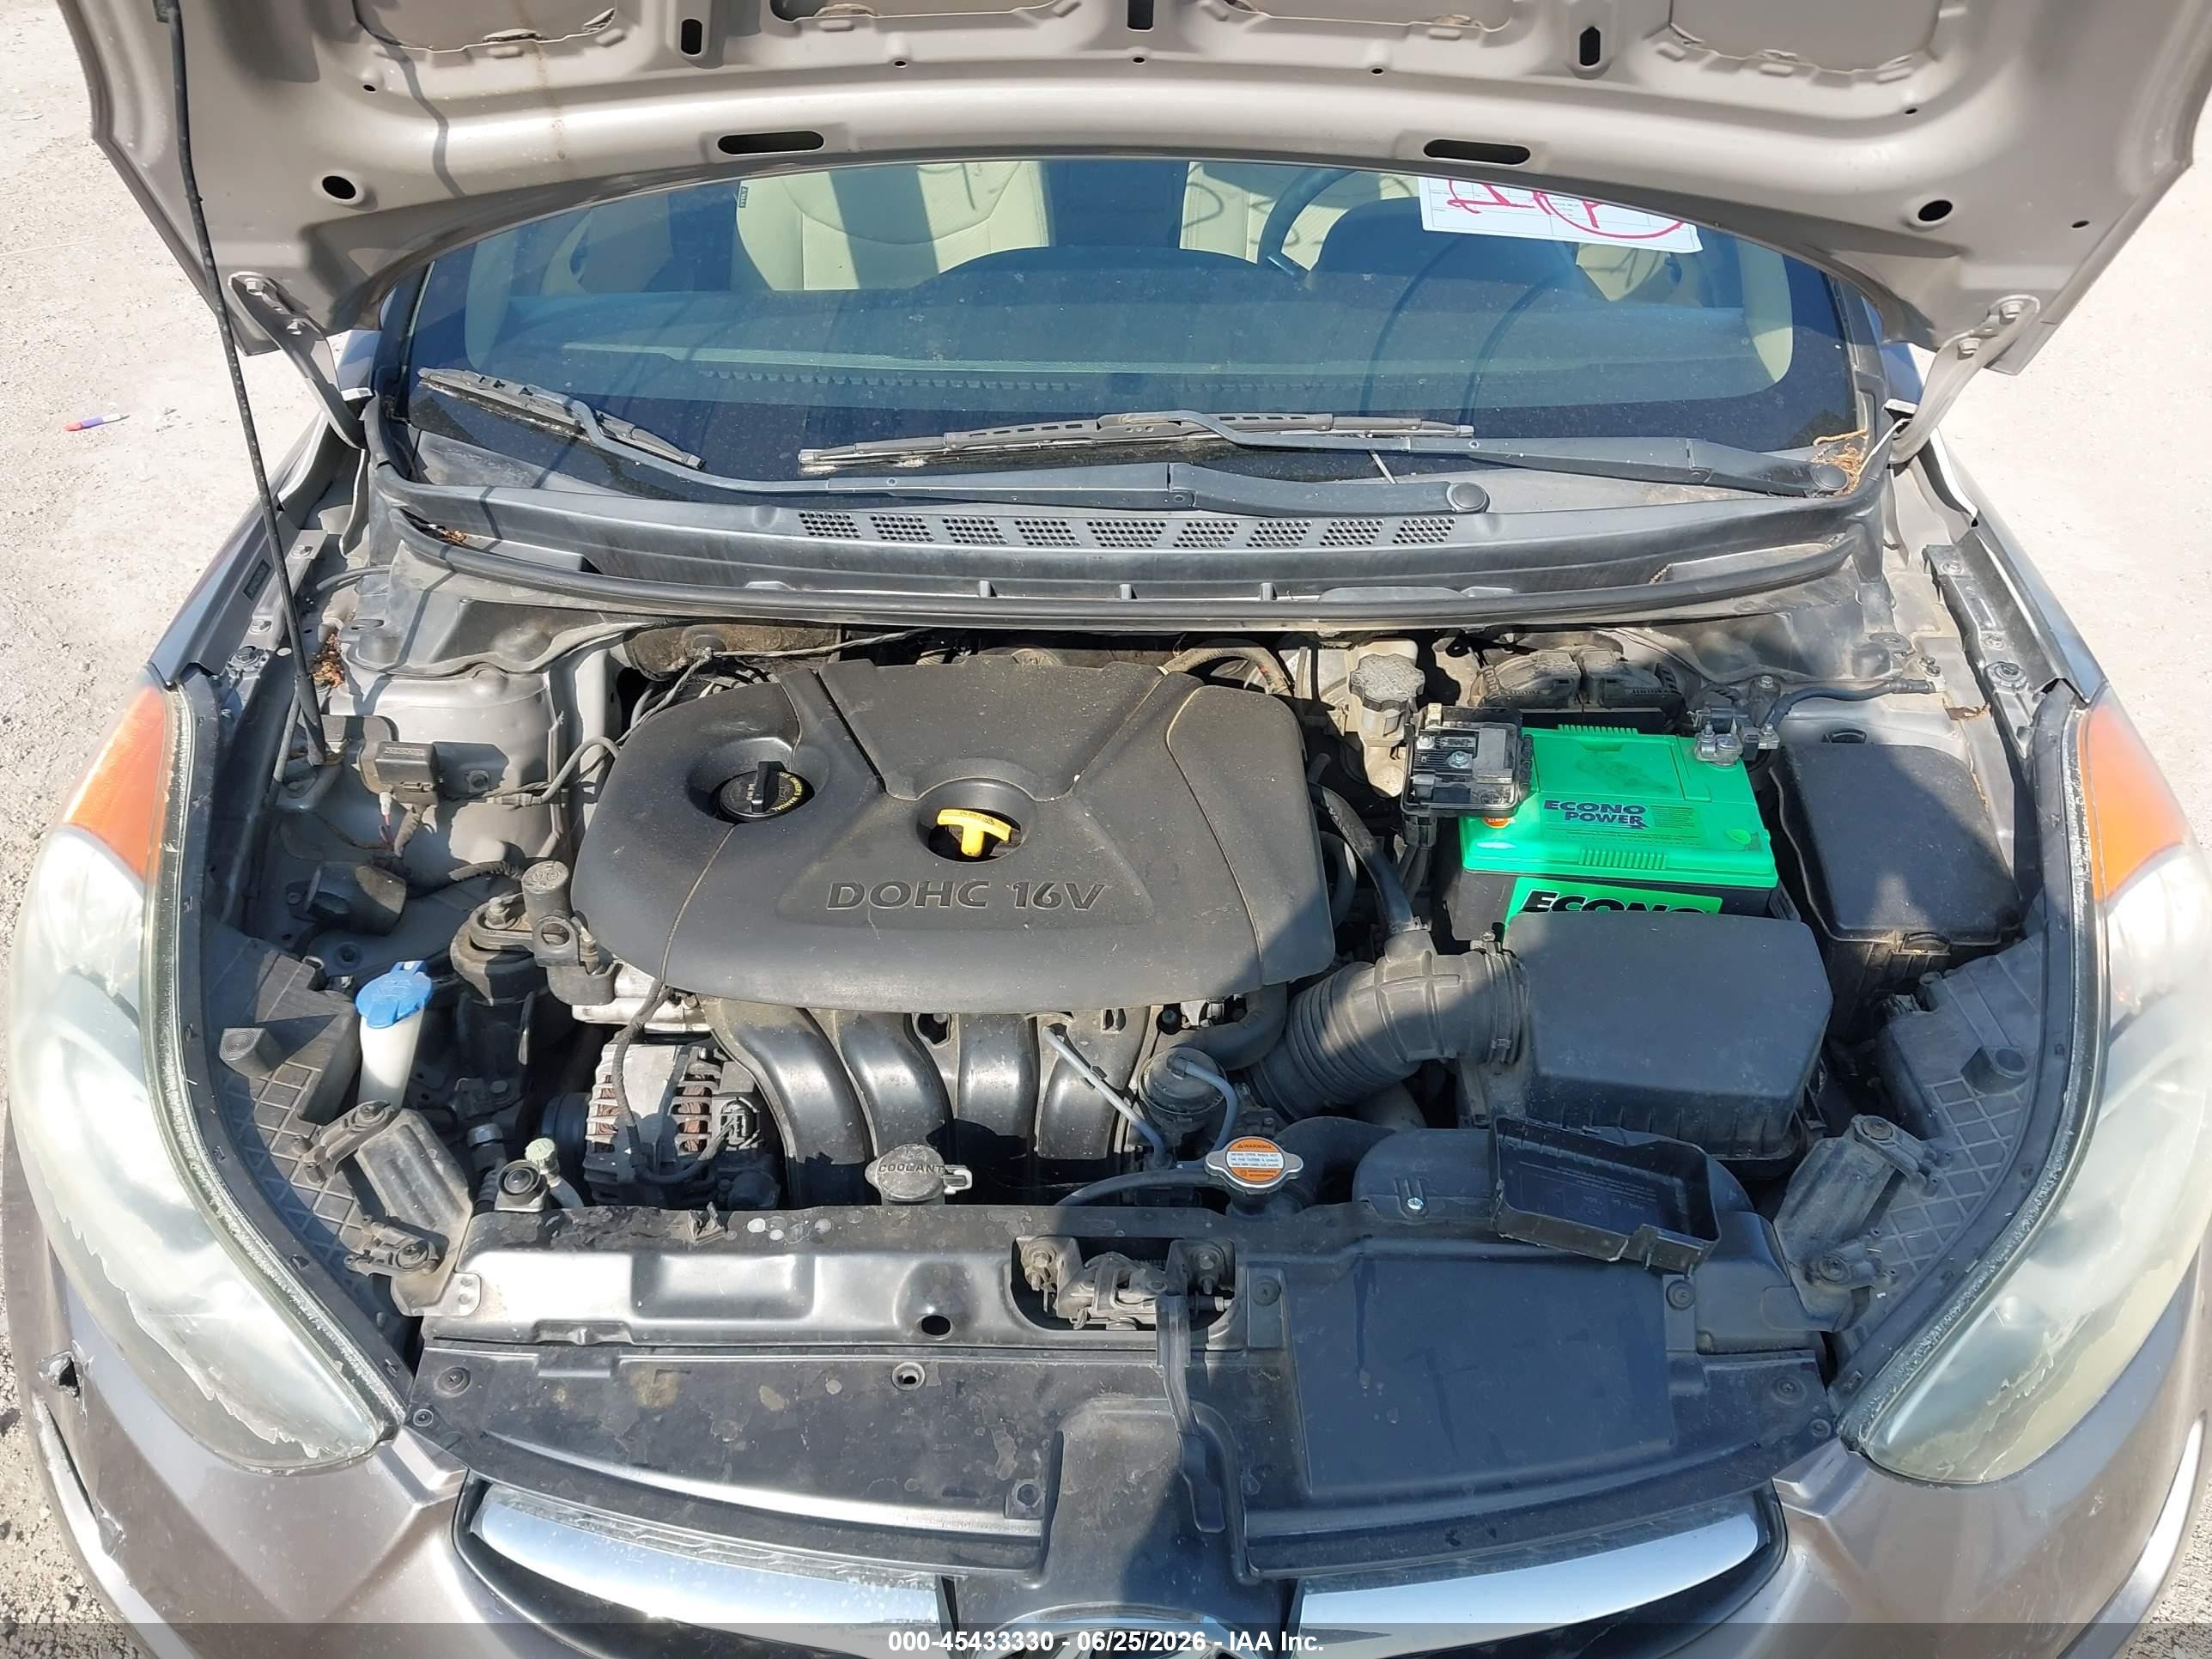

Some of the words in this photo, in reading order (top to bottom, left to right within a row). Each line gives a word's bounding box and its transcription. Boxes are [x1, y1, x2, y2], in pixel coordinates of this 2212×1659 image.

[1543, 799, 1647, 815] ECONO
[1564, 811, 1650, 830] POWER
[826, 880, 989, 910] DOHC
[1008, 880, 1108, 911] 16V
[878, 1164, 946, 1176] COOLANT
